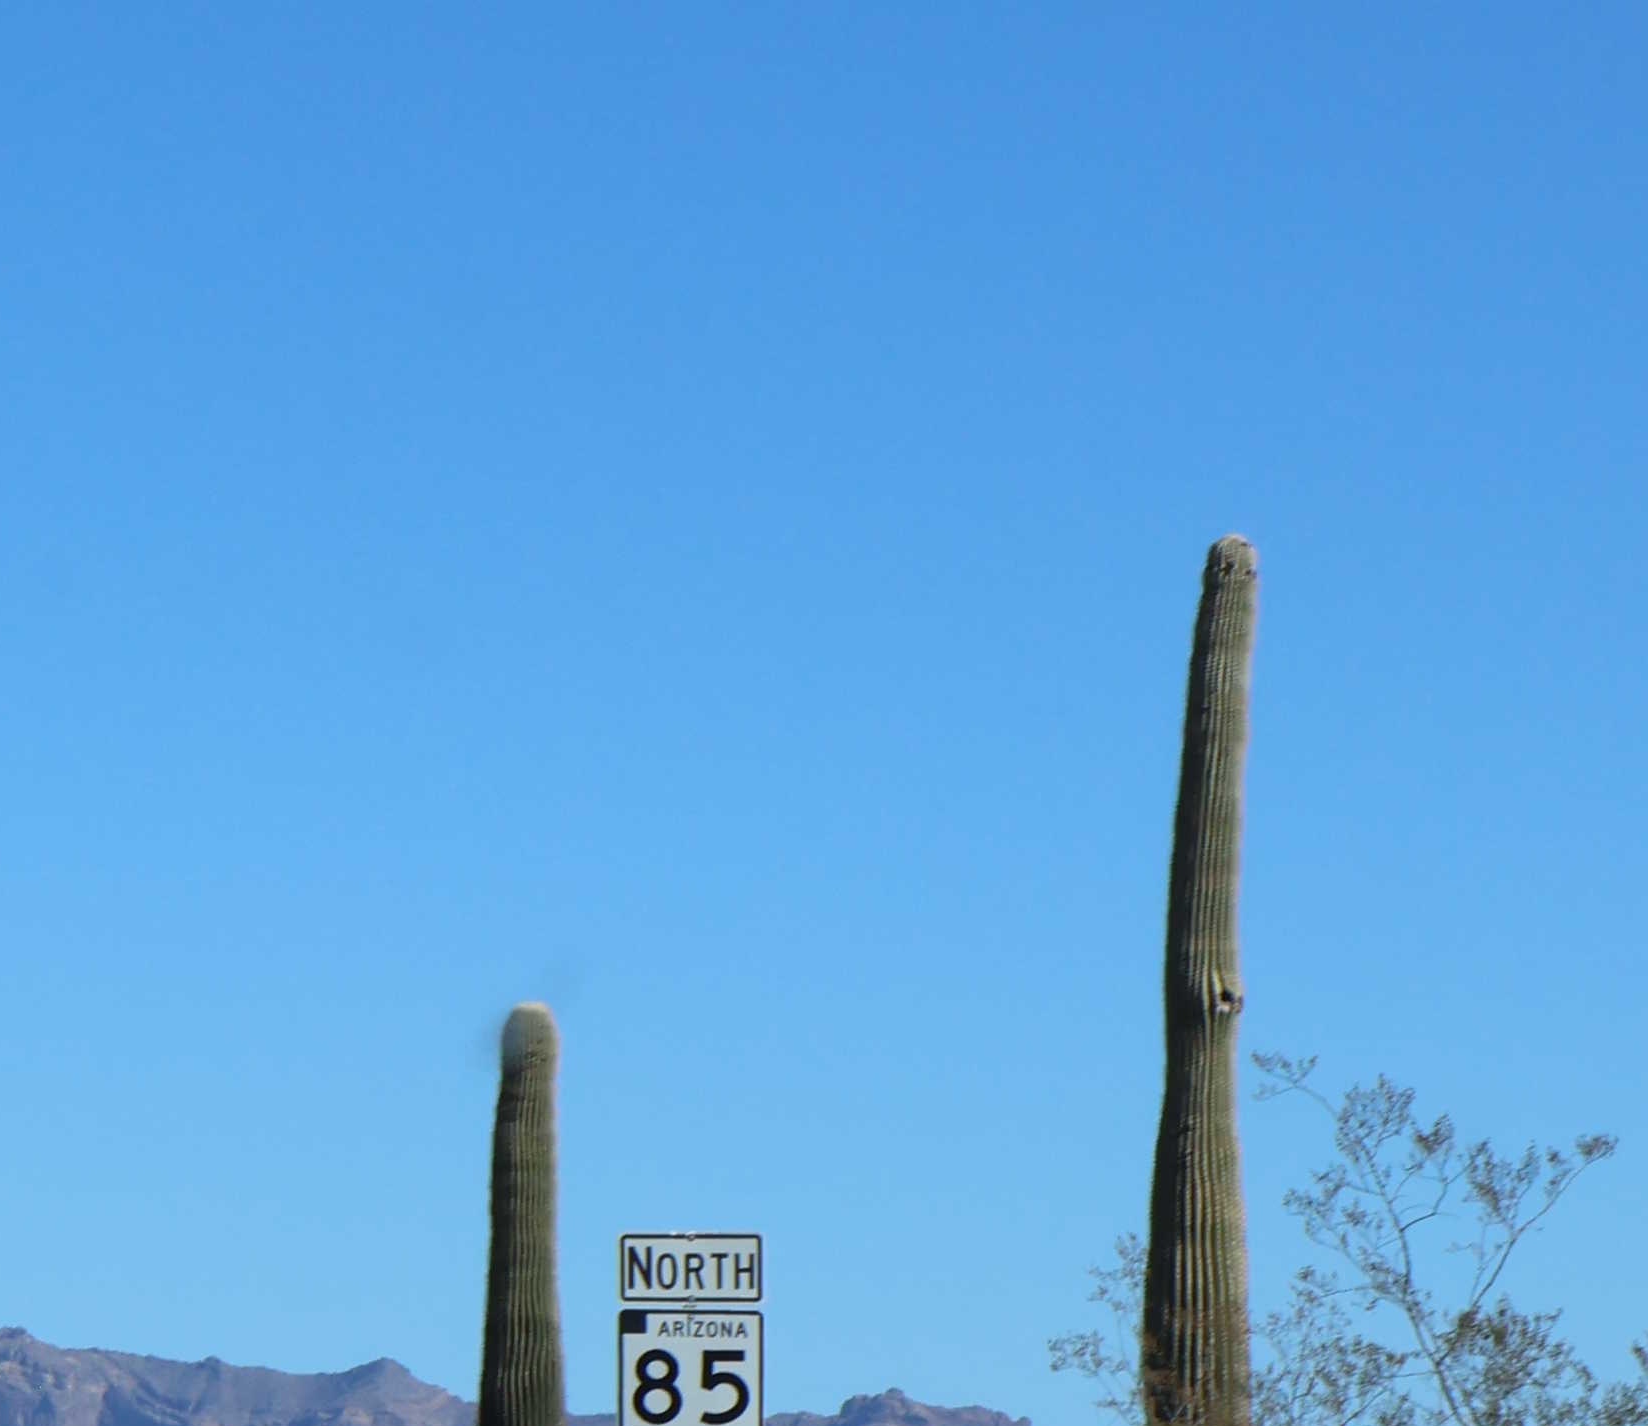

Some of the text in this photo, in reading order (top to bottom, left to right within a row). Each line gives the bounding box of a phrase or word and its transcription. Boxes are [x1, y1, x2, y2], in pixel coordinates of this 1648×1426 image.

[627, 1246, 755, 1290] NORTH
[657, 1320, 748, 1338] ARIZONA
[633, 1349, 750, 1424] 85
